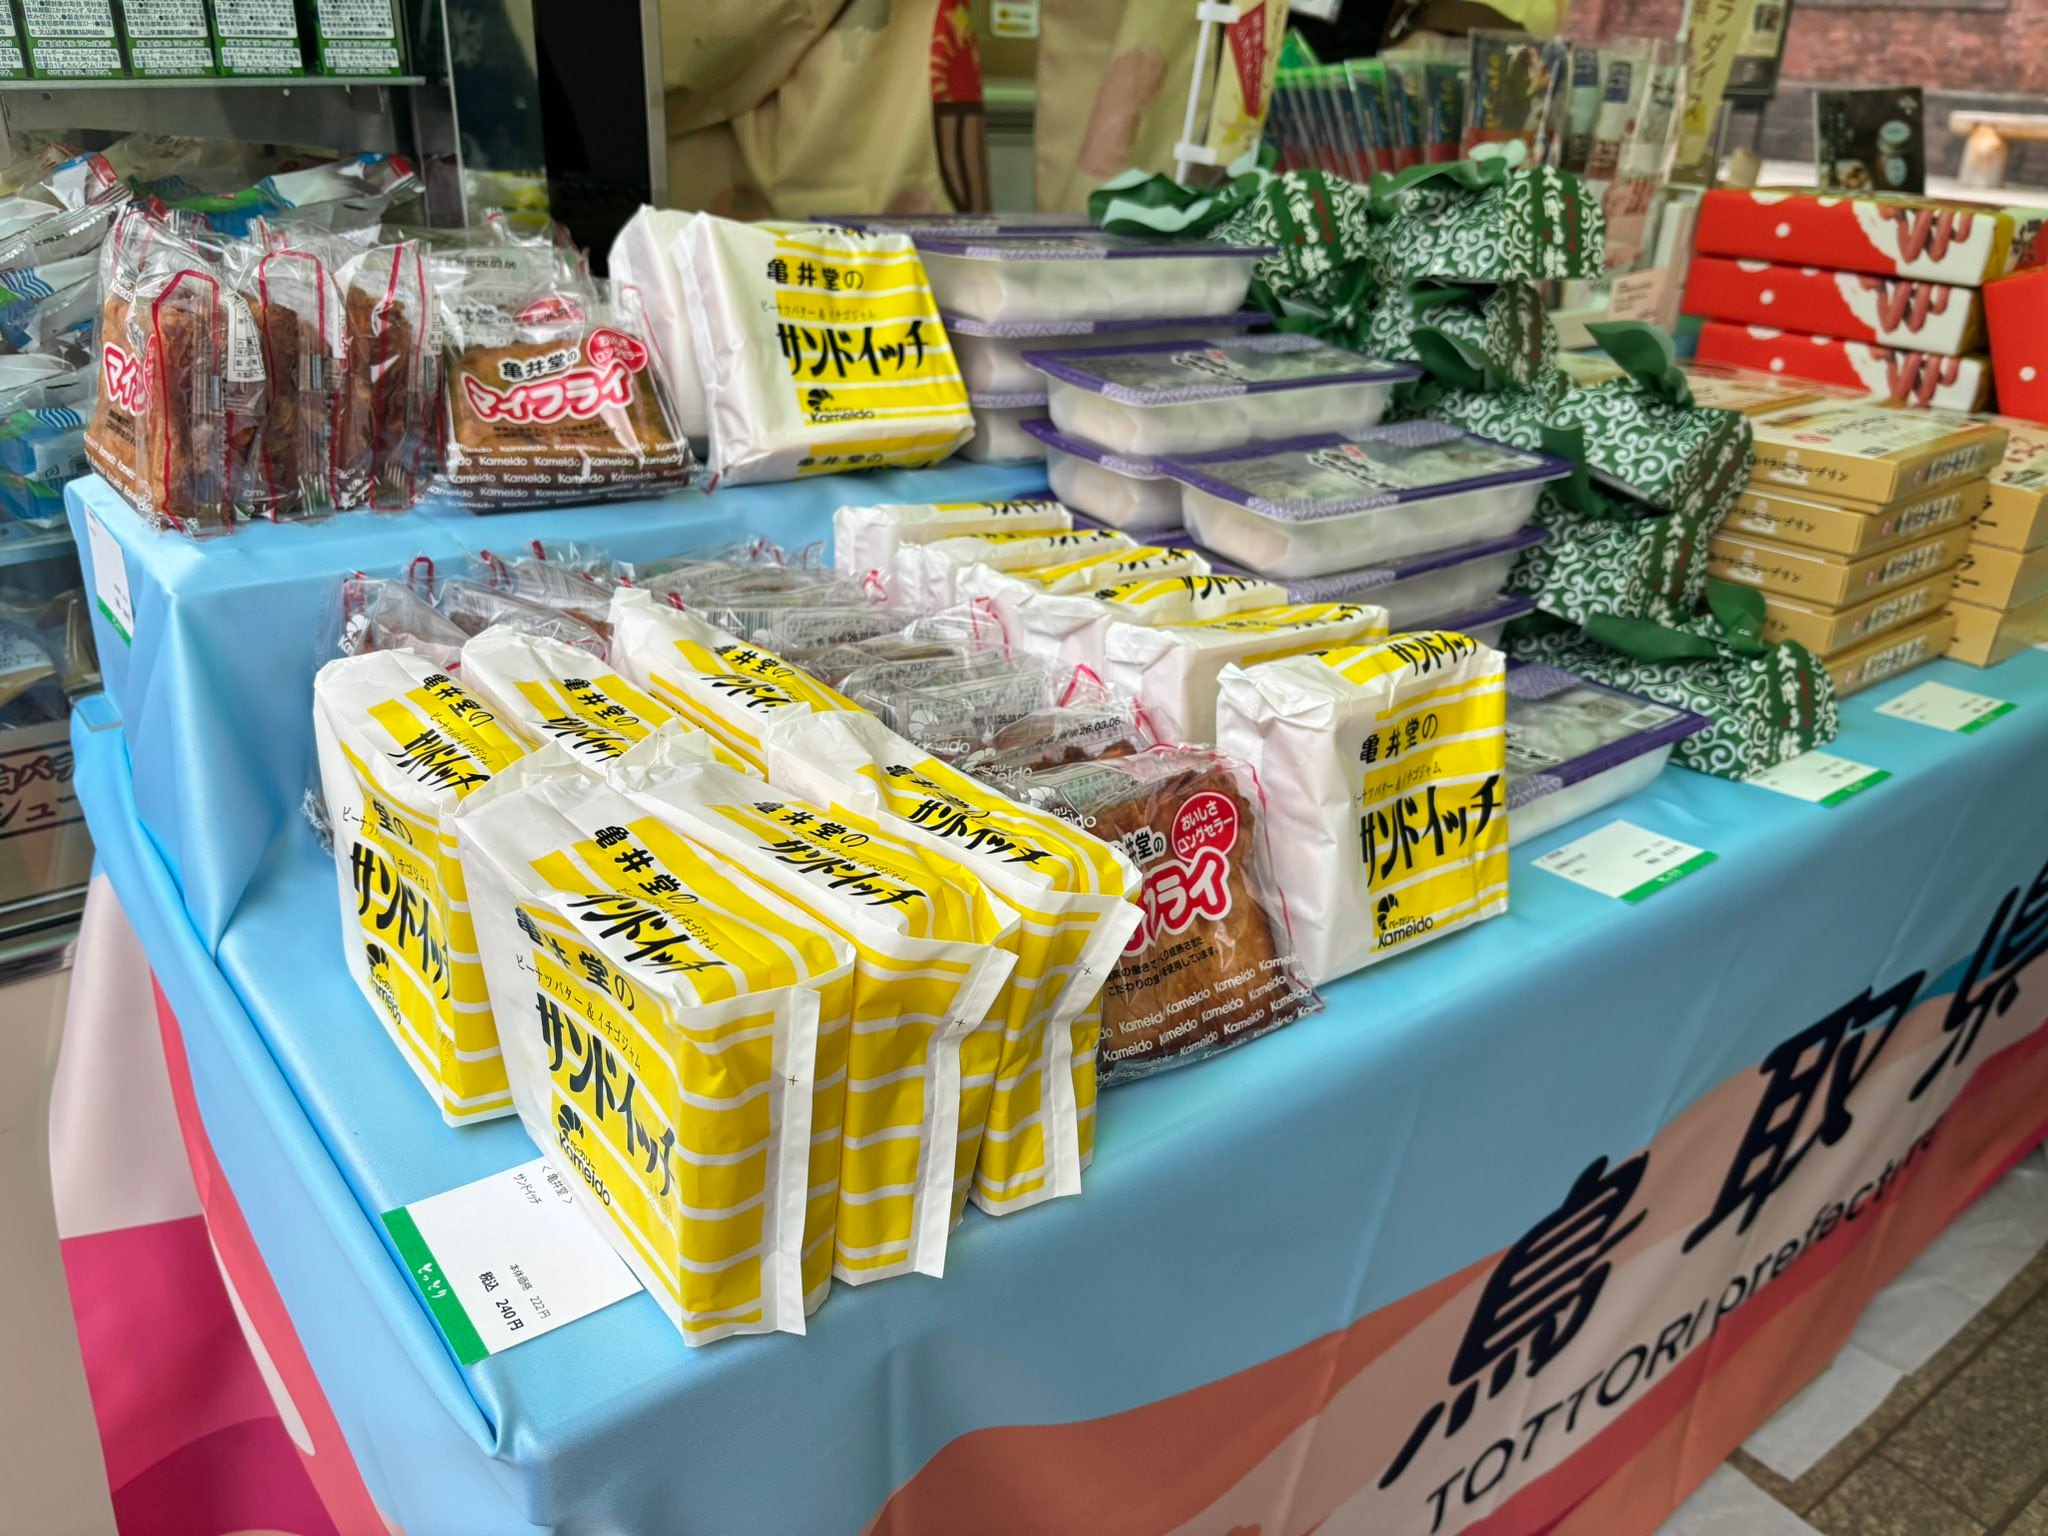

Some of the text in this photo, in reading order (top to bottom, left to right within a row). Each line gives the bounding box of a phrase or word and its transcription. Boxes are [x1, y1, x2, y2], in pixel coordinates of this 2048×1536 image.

[767, 258, 864, 291] 亀井堂の
[501, 350, 578, 379] 亀井堂の
[777, 320, 929, 378] サンドイッチ
[464, 361, 633, 423] マイフライ
[810, 409, 875, 424] Kameido
[479, 456, 528, 467] Kameido
[534, 457, 581, 467] Kameido
[503, 474, 551, 484] Kameido
[480, 488, 528, 498] Kameido
[423, 673, 495, 727] 亀井堂の
[563, 678, 640, 727] 亀井堂の
[1079, 716, 1121, 736] 26.03.06
[387, 728, 491, 792] サンドイッチ
[1359, 713, 1438, 764] 亀井堂の
[753, 801, 870, 848] 亀井堂の
[902, 799, 1053, 866] サンドイッチ
[1177, 816, 1235, 855] ロングセラー
[1180, 800, 1218, 832] おいしさ
[1360, 774, 1501, 888] サンドイッチ
[595, 825, 699, 905] 亀井堂の
[758, 838, 928, 906] サンドイッチ
[566, 893, 728, 975] サンドイッチ
[1377, 915, 1434, 949] Kameido
[515, 906, 635, 1012] 亀井堂の
[1165, 988, 1211, 1016] Kameido
[1213, 968, 1256, 994] Kameido
[1223, 1009, 1265, 1036] Kameido
[1270, 987, 1312, 1014] Kameido
[598, 1012, 641, 1072] イチゴジャム
[1103, 1039, 1153, 1063] Kameido
[1201, 997, 1244, 1024] Kameido
[1248, 974, 1287, 1002] Kameido
[535, 991, 676, 1197] サンドイッチ
[513, 1172, 543, 1205] サンドイッチ
[557, 1132, 612, 1207] Kameido
[417, 1262, 448, 1299] とっとり
[478, 1271, 525, 1331] 税込 240円
[509, 1263, 551, 1319] 本体価格 222円
[1425, 1297, 1708, 1534] TOTTORI
